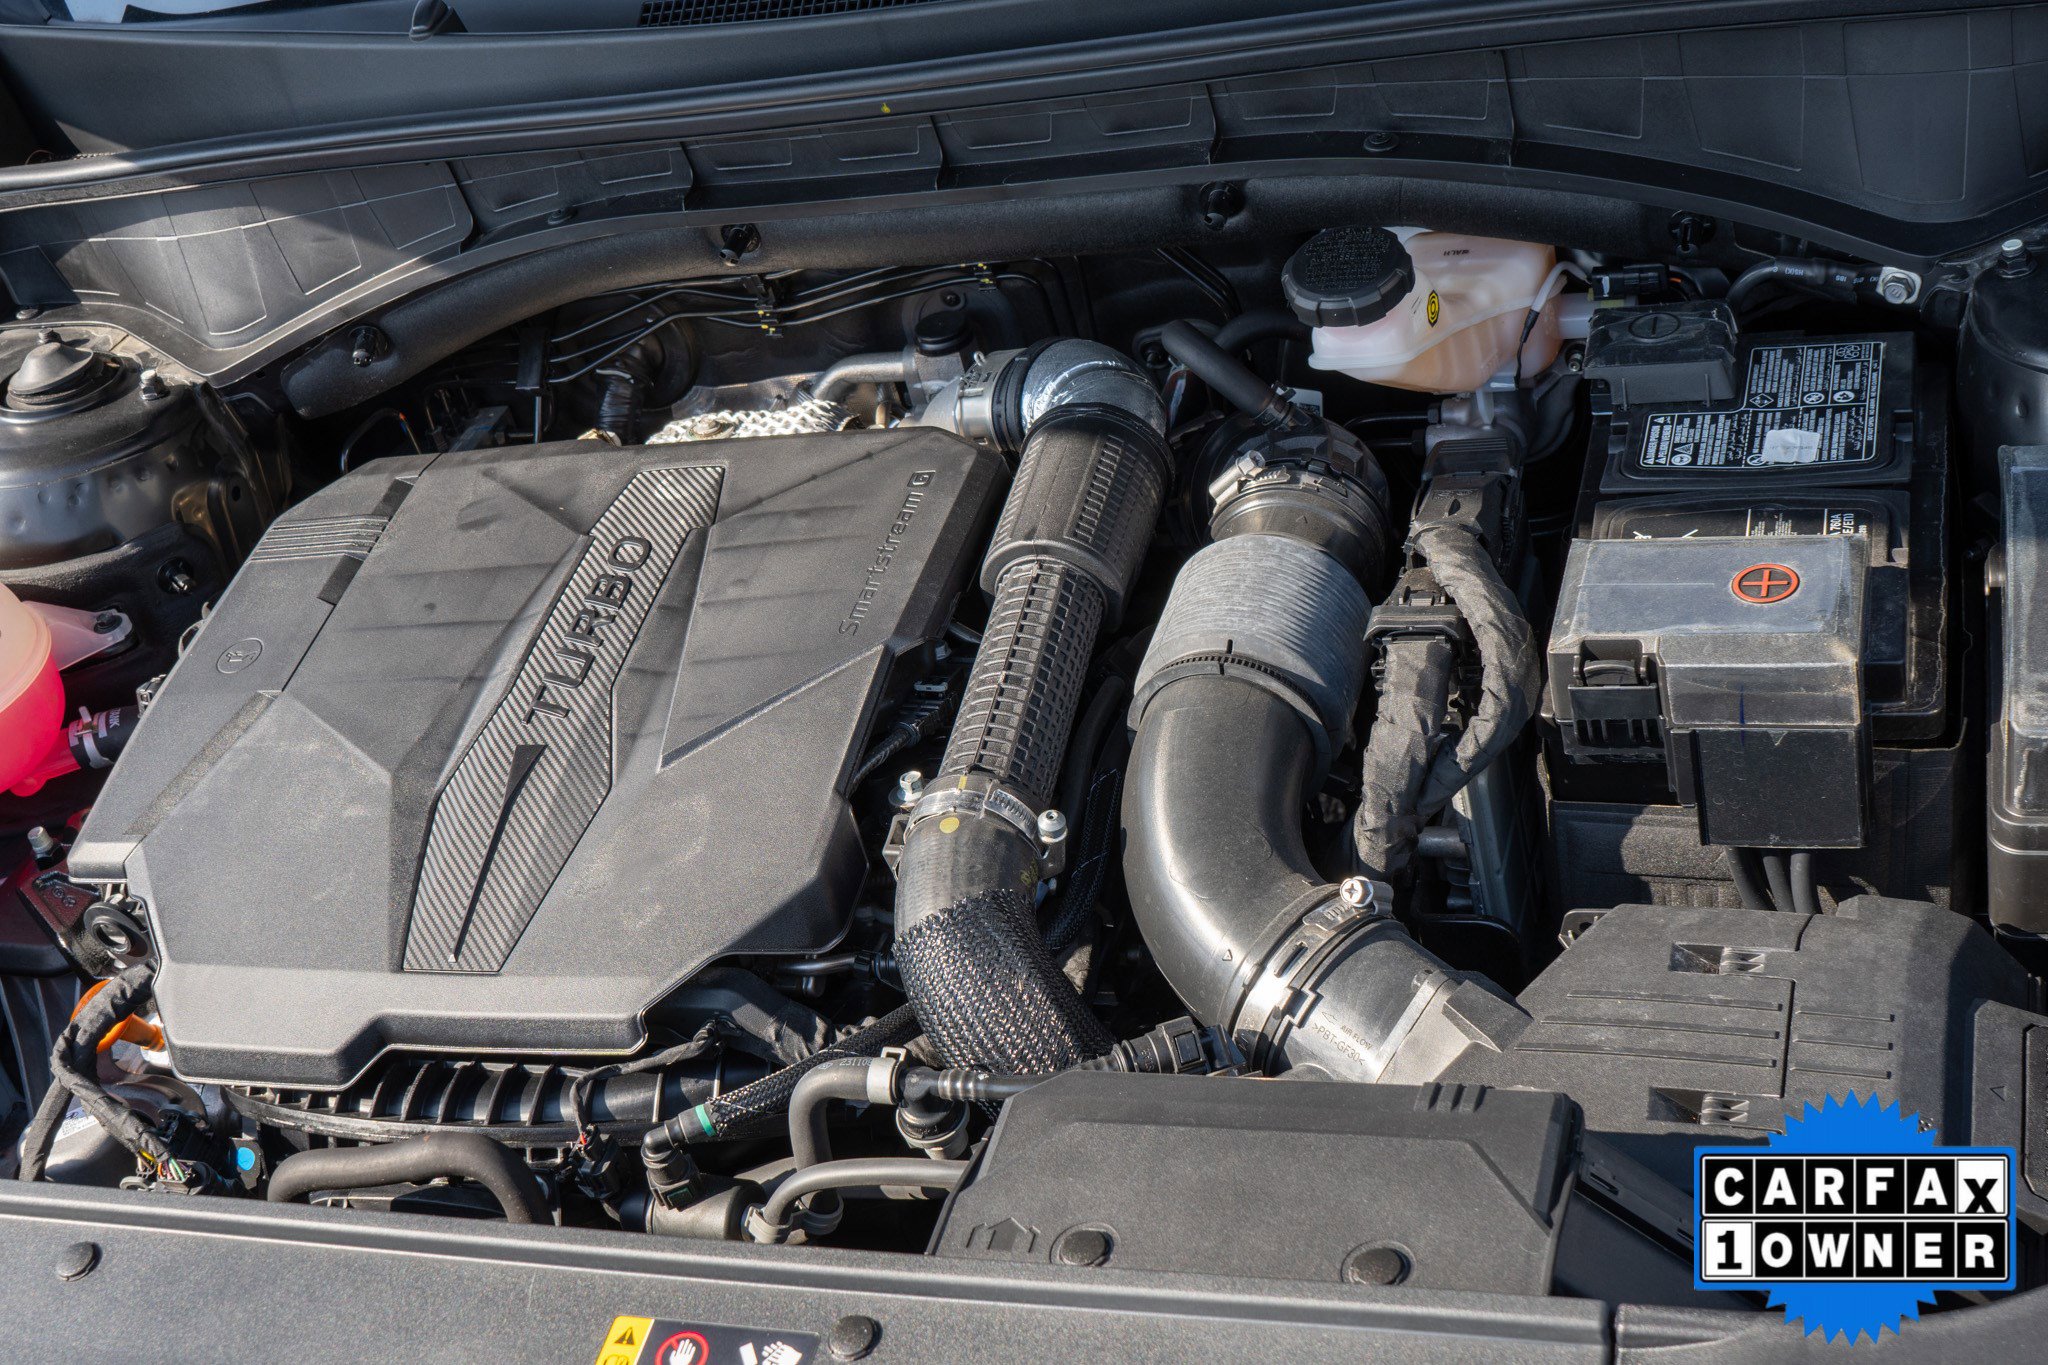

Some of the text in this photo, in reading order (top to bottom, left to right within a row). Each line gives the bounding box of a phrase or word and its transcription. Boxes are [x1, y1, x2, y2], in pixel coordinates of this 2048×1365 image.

[839, 491, 924, 636] Smartstream
[1829, 513, 1842, 531] 760A
[521, 535, 653, 726] TURBO
